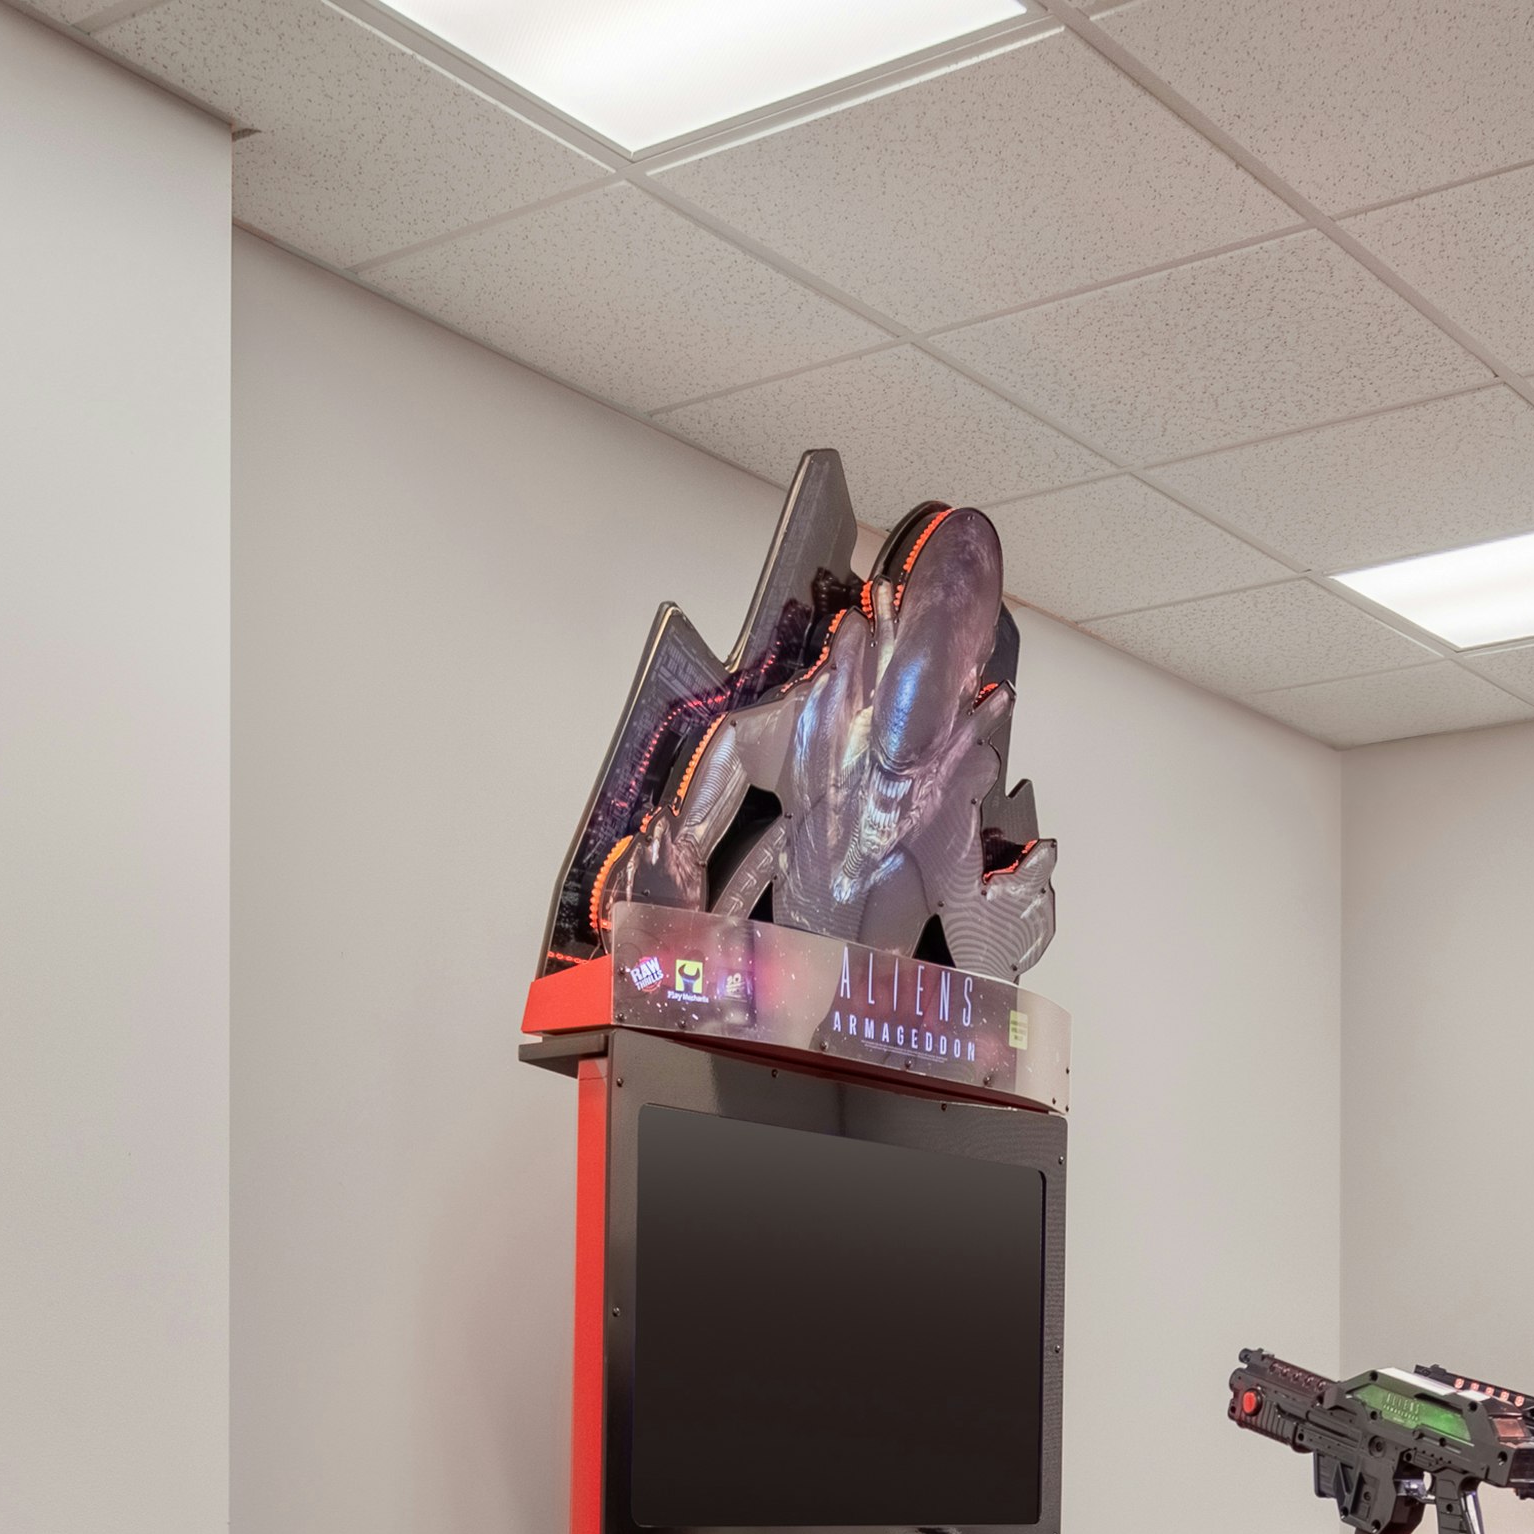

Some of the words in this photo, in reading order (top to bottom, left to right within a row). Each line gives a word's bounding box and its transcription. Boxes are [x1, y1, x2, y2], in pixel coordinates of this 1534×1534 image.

[630, 957, 660, 983] RAW
[636, 969, 664, 990] THRILLS
[840, 946, 974, 1027] ALIENS
[833, 1011, 975, 1061] ARMAGEDDON
